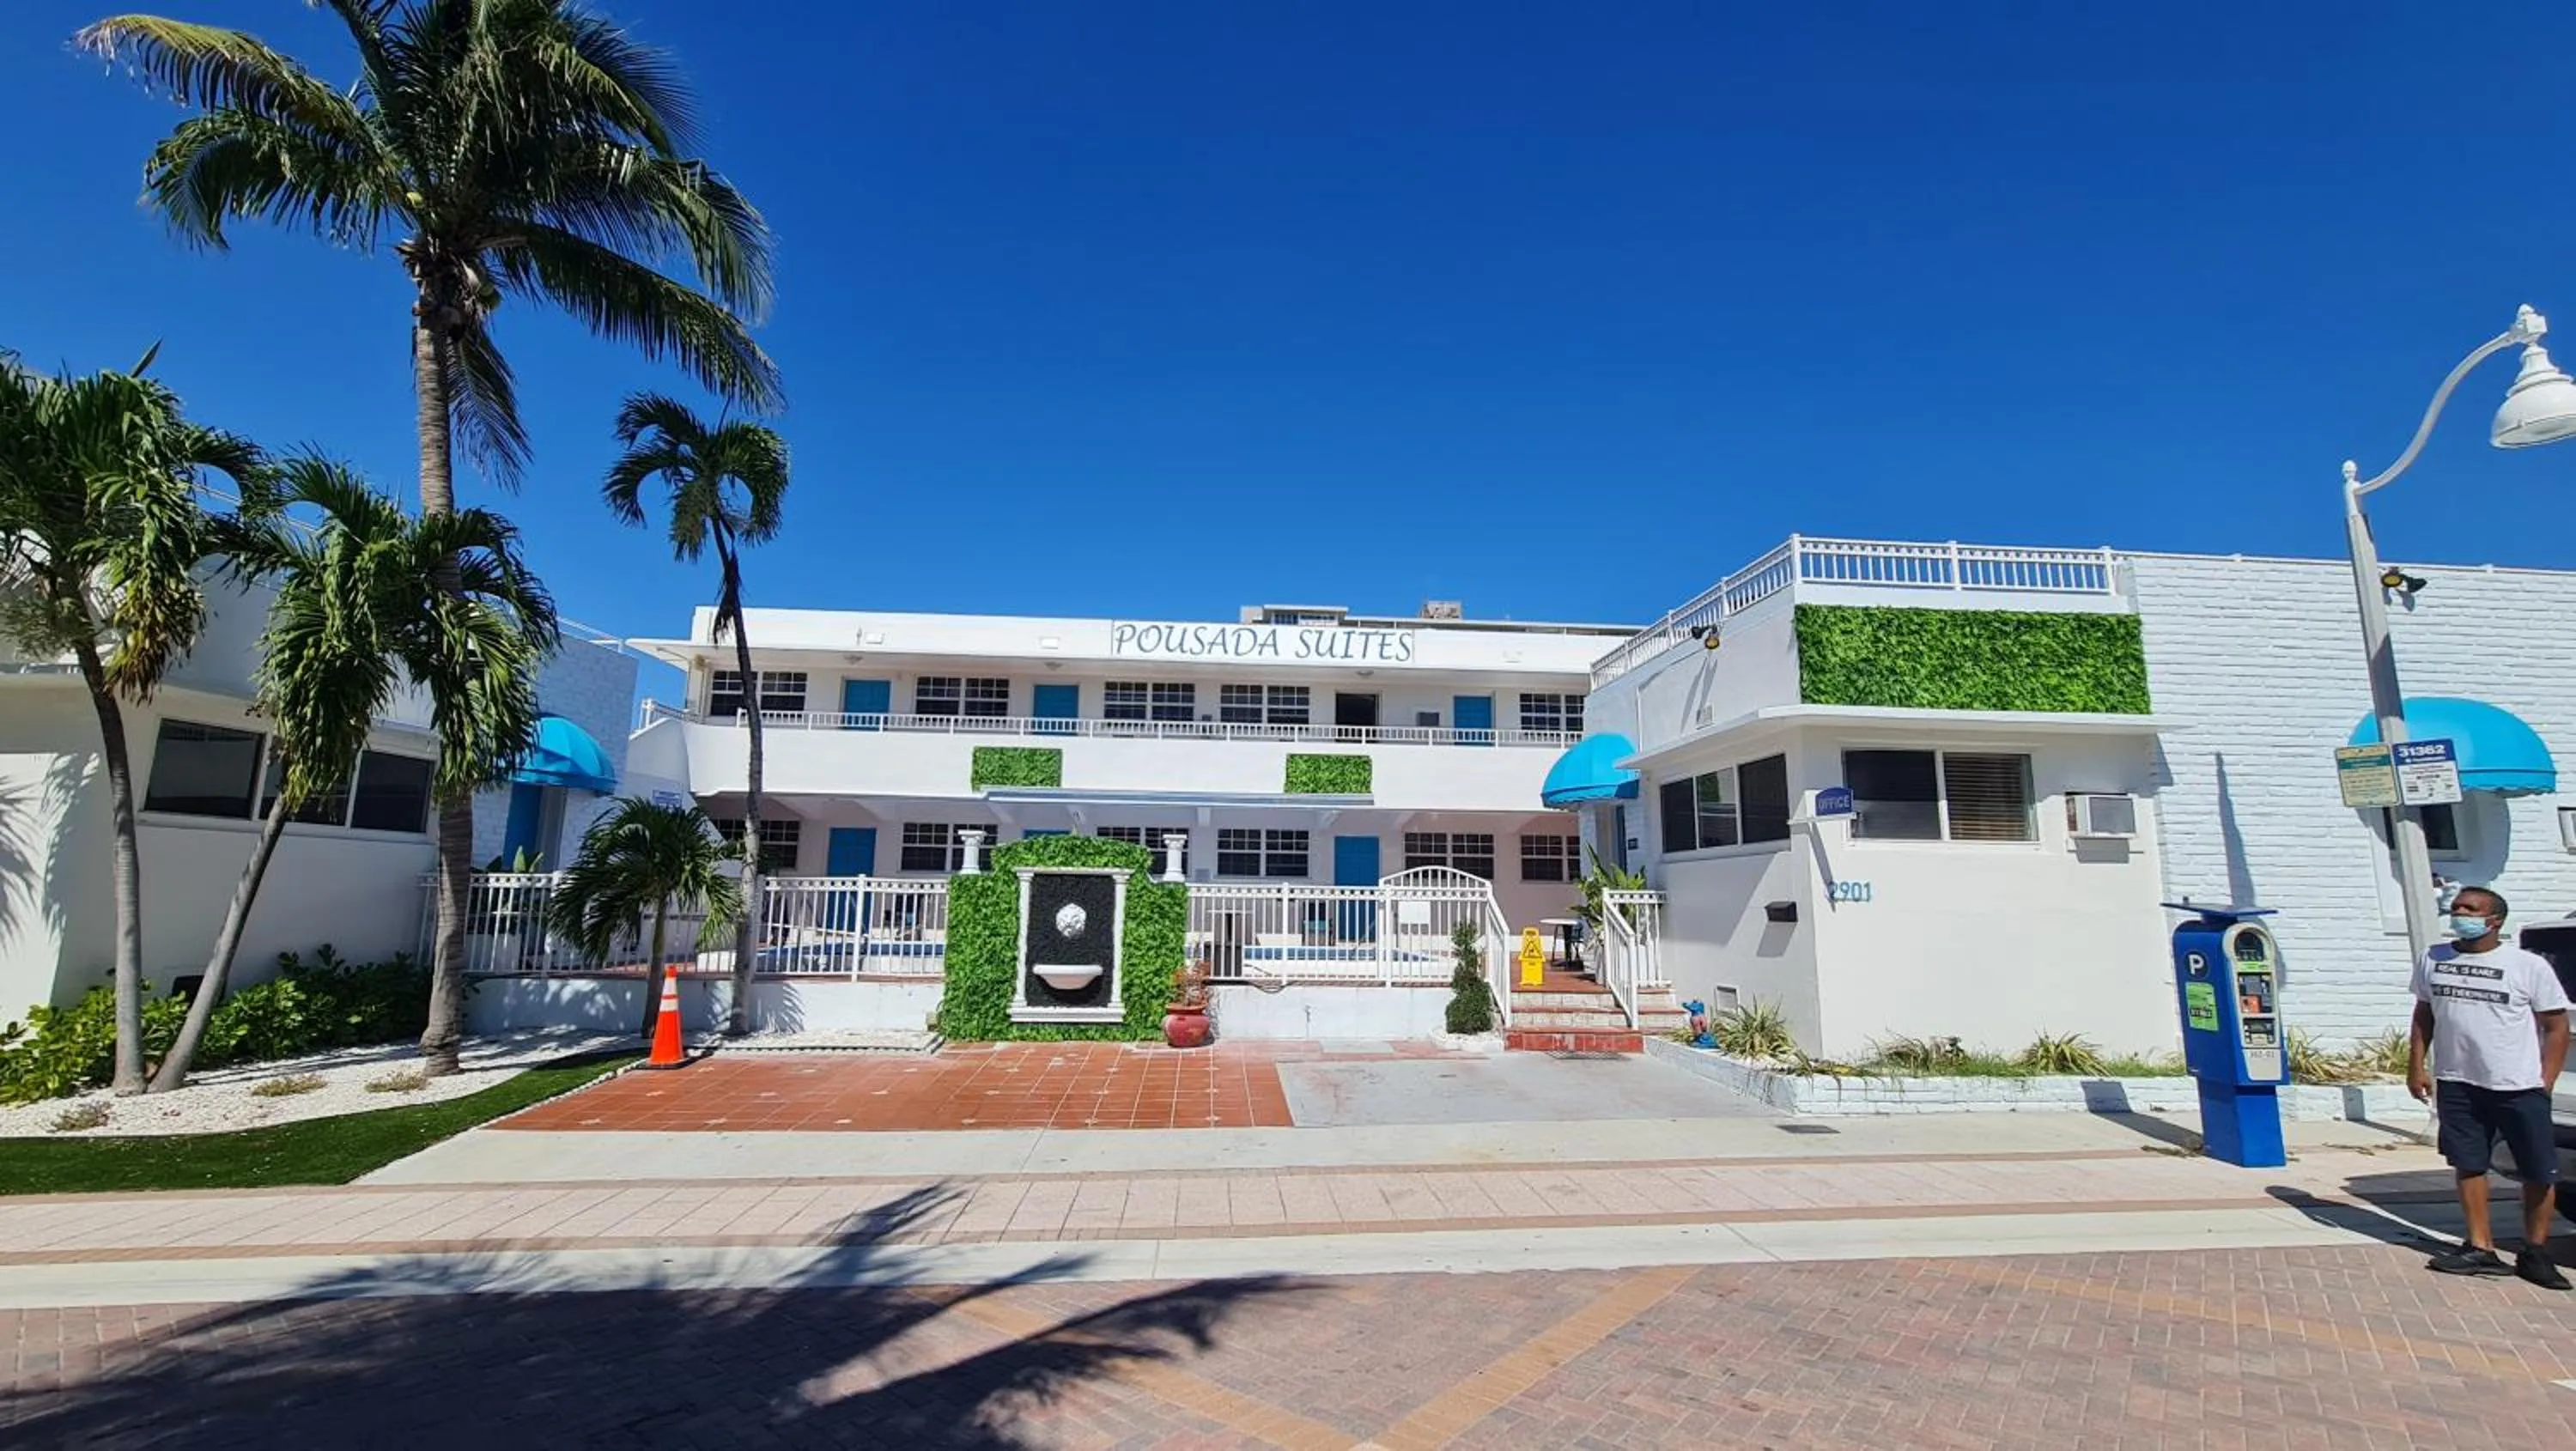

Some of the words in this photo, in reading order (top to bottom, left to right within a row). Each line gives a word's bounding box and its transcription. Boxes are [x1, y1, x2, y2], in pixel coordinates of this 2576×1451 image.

[1115, 624, 1279, 657] POUSADA
[1295, 628, 1413, 661] SUITES
[1818, 794, 1850, 810] OFFICE
[1830, 881, 1870, 902] 2901
[2189, 954, 2205, 975] P
